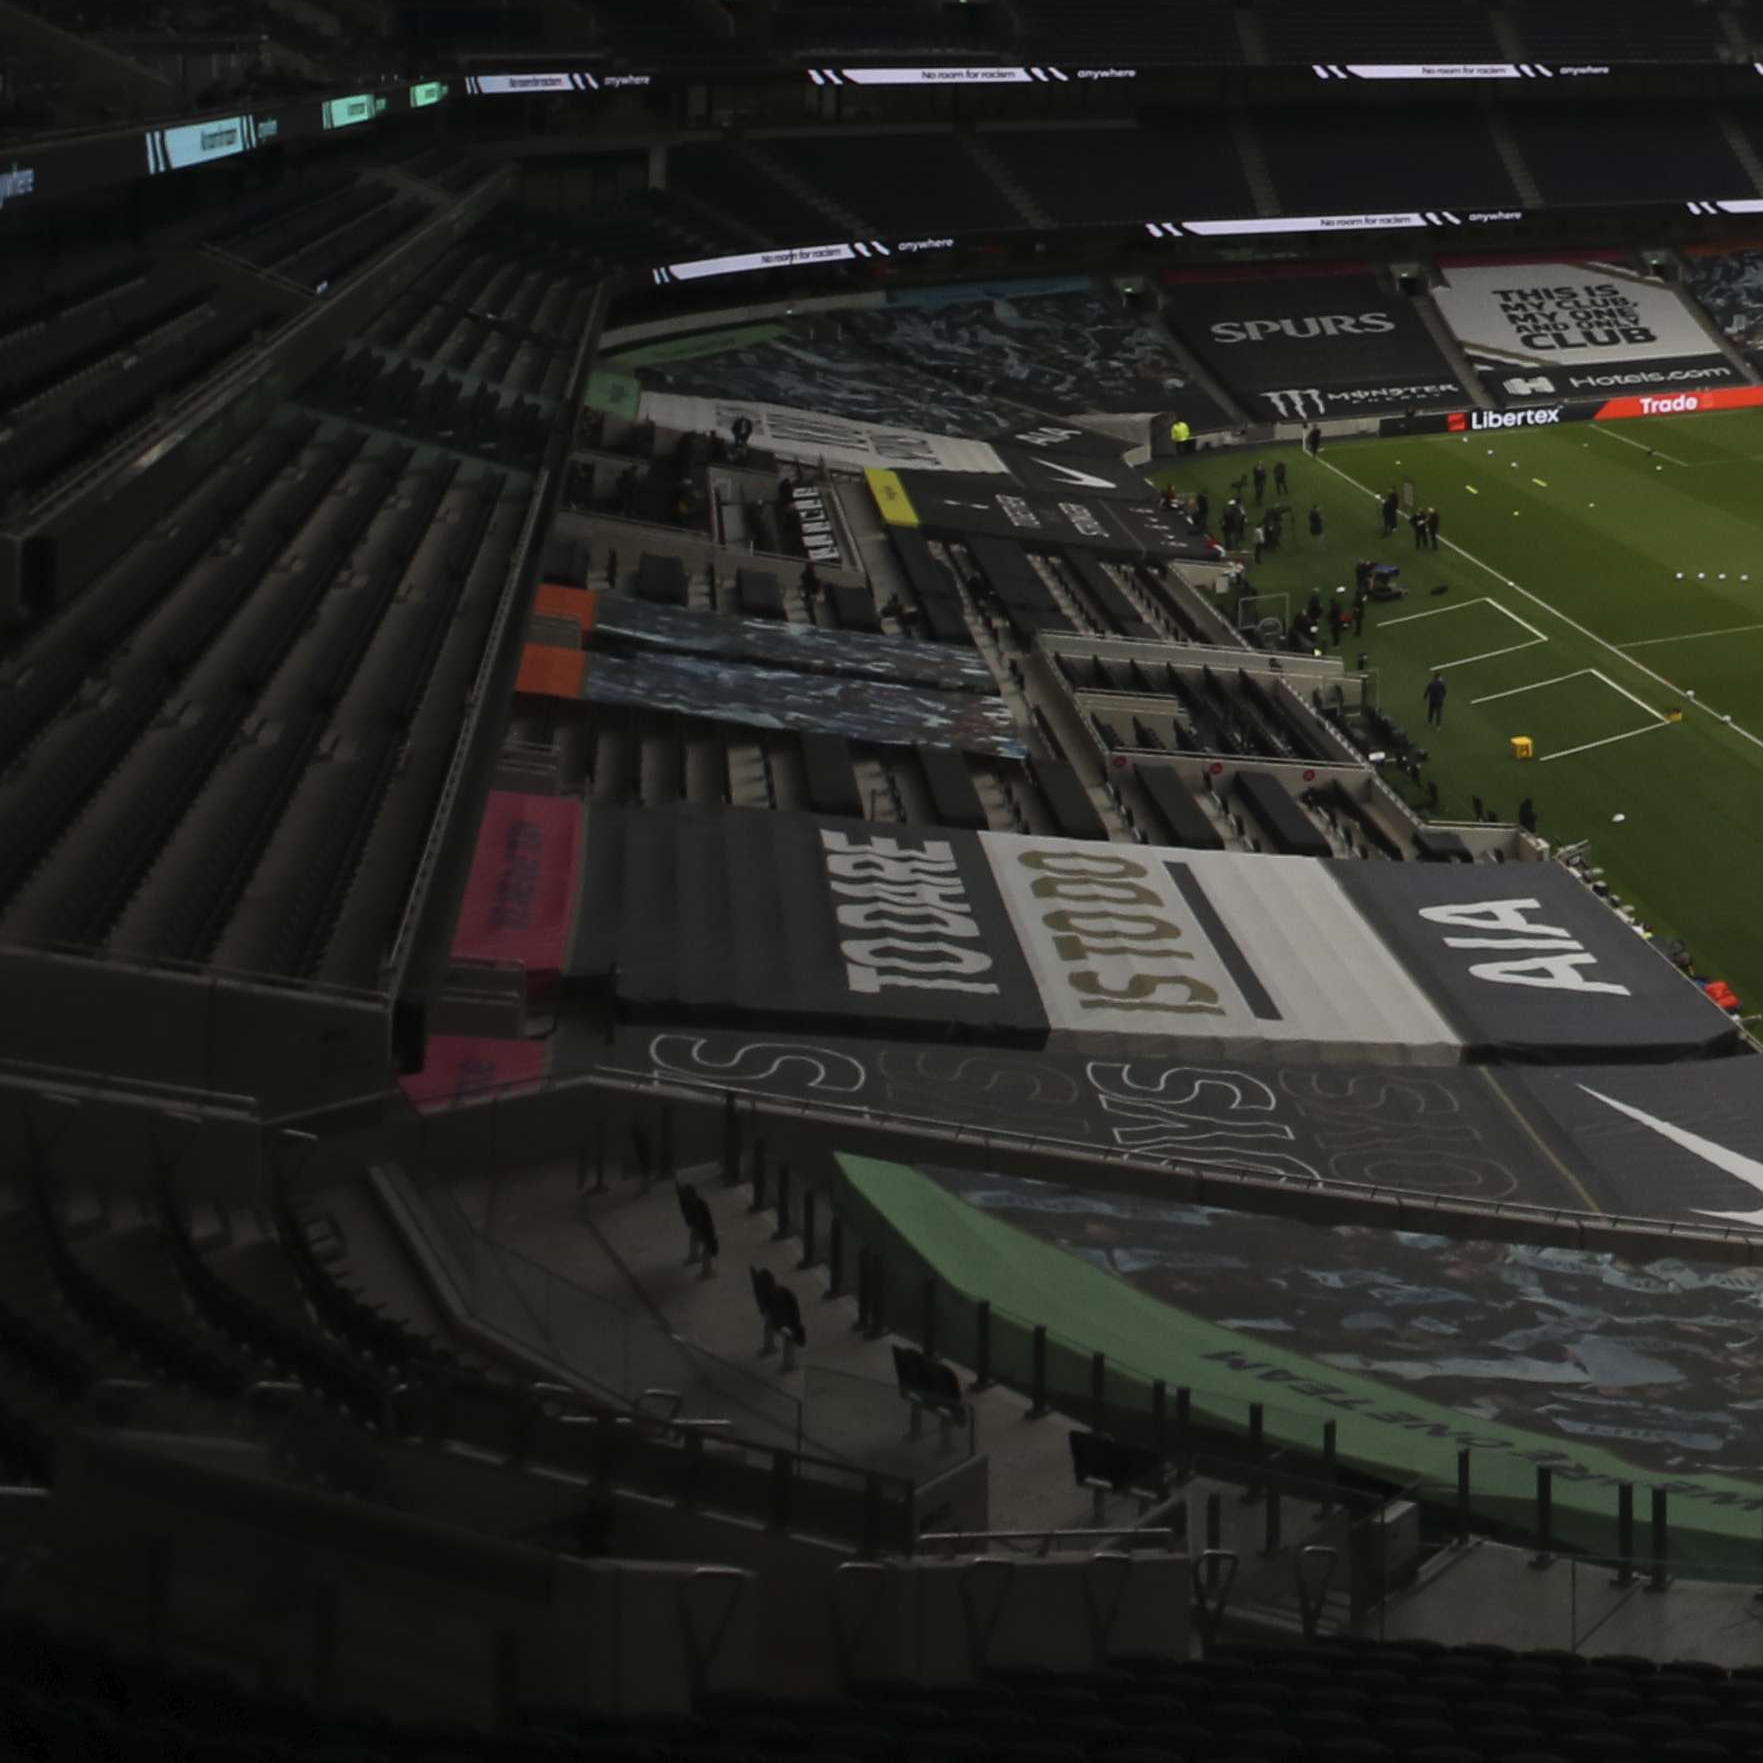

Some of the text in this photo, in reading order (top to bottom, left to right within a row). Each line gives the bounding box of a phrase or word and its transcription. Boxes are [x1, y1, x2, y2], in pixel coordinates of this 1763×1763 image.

[966, 70, 980, 79] for
[981, 70, 1015, 79] racism
[1077, 69, 1136, 80] anywhere
[1559, 66, 1609, 76] anywhere
[1364, 217, 1378, 226] for
[1379, 216, 1411, 225] racism
[1468, 211, 1522, 223] anywhere
[897, 238, 954, 252] anywhere
[1492, 283, 1619, 302] THIS IS
[1499, 302, 1553, 314] MY
[1506, 308, 1640, 325] MY ONE
[1210, 312, 1395, 343] SPURS
[1515, 316, 1639, 334] AND ONLY
[1520, 327, 1657, 349] CLUB
[1568, 365, 1732, 388] Hotels.com
[1639, 394, 1699, 415] Trade
[1471, 406, 1560, 431] Libertex
[819, 828, 981, 937] DARE
[1018, 850, 1226, 1016] IS TO DO
[1418, 897, 1632, 997] AIA
[840, 937, 1000, 995] TO
